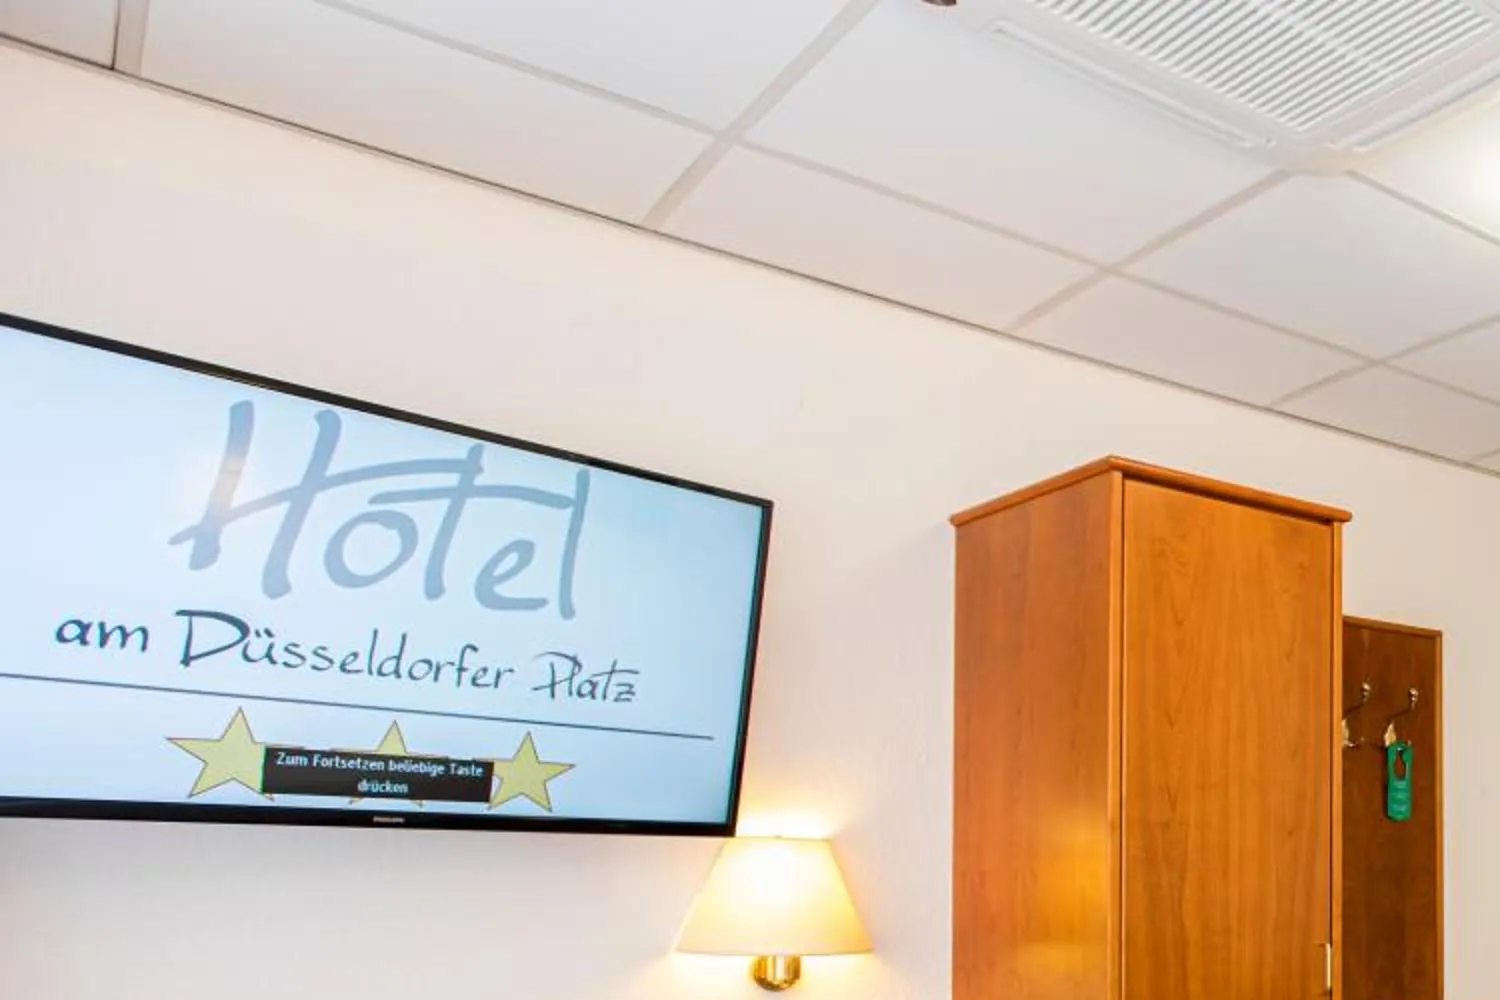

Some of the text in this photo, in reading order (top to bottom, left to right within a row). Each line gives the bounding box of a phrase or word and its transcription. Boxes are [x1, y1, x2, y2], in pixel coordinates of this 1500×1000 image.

[168, 399, 591, 620] Hotel
[55, 608, 642, 703] am Düsseldorfer Platz
[276, 751, 483, 778] Zum Fortsetzen beliebige Taste
[357, 778, 409, 794] drücken
